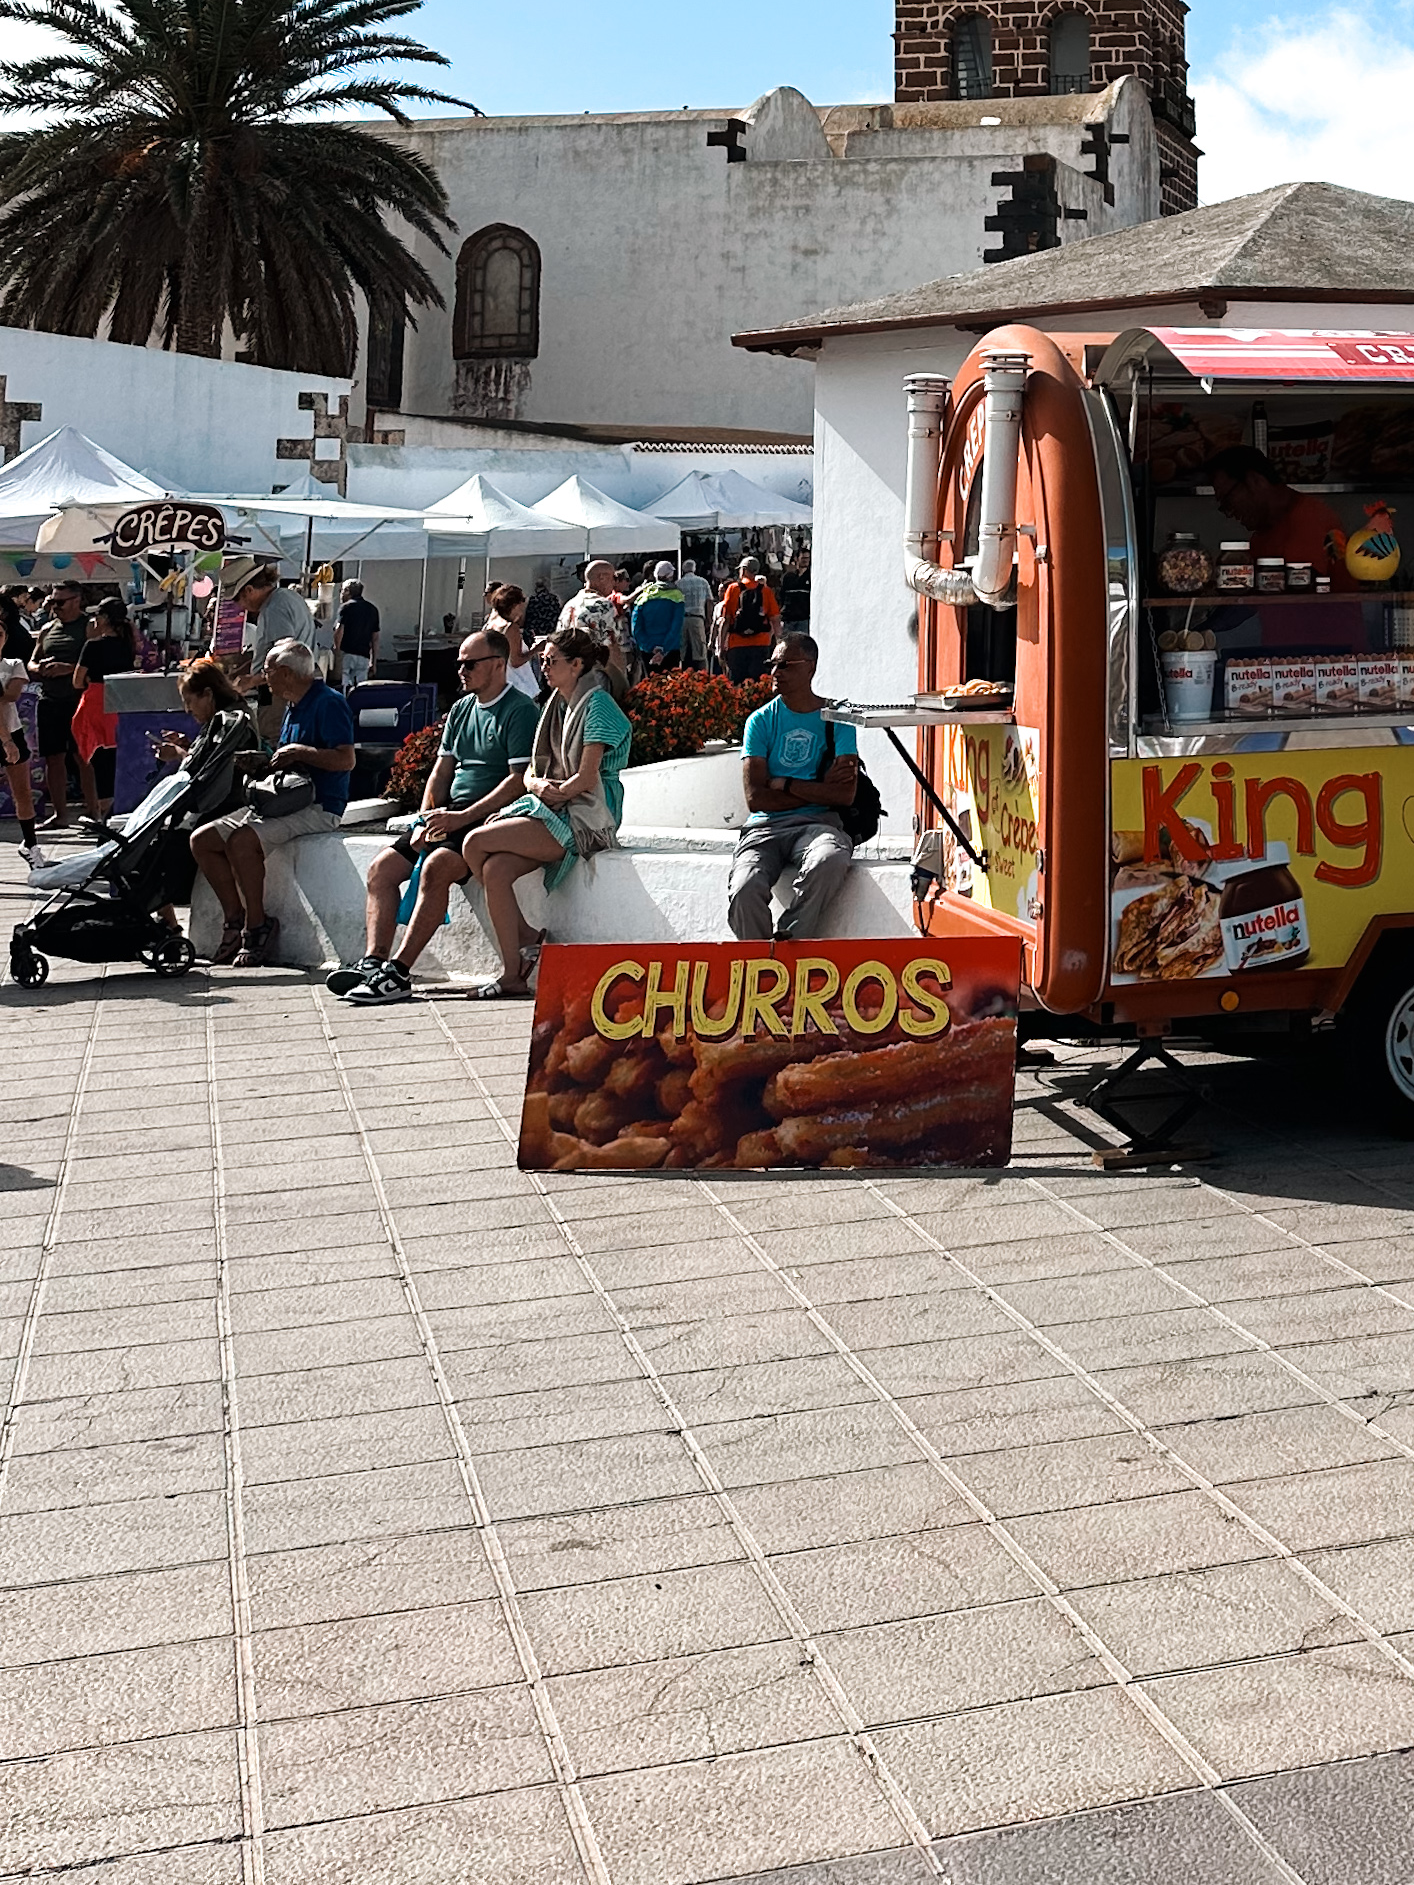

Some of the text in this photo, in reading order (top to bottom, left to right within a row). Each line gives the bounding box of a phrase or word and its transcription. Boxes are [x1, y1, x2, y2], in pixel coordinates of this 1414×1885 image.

[960, 403, 985, 501] CREP
[1269, 438, 1330, 458] utella
[115, 504, 224, 547] CRÊPES
[1231, 669, 1270, 681] nutella
[1275, 666, 1314, 680] nutella
[1318, 665, 1356, 677] nutella
[1360, 663, 1398, 676] nutella
[1142, 762, 1382, 888] King
[1232, 906, 1300, 940] nutella
[591, 958, 952, 1042] CHURROS
